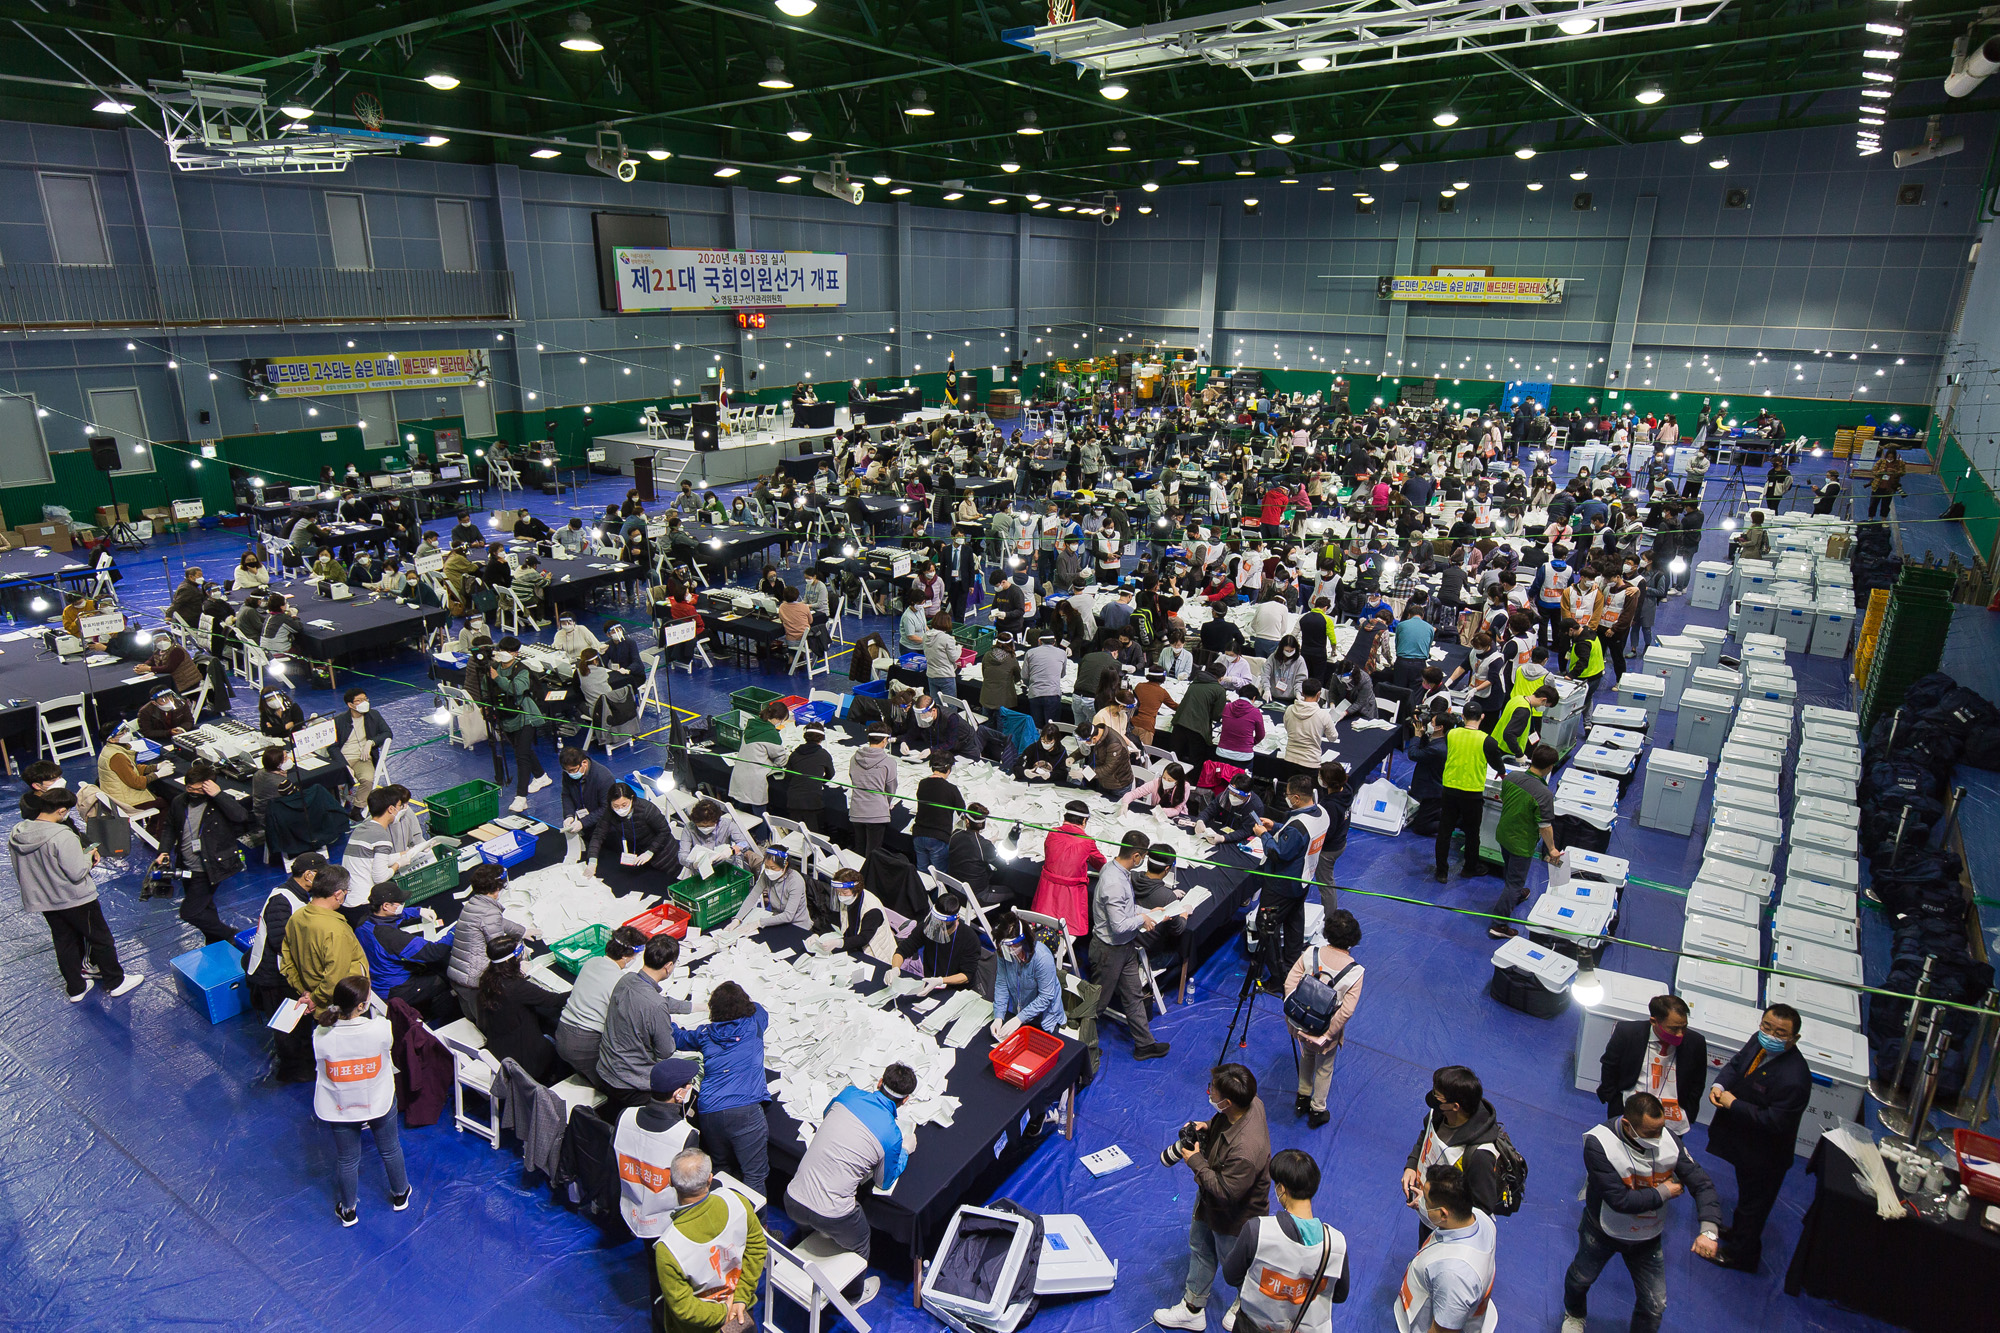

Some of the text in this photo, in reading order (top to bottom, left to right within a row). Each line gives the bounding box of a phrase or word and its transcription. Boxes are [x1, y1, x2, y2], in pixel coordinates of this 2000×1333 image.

[698, 253, 787, 266] 2020년 4월 15일 실시
[631, 266, 840, 294] 제21대 국회의원선거 개표
[1391, 280, 1547, 294] 배드민턴 고수되는 숨은 비결!! 배드민턴 필라테스
[721, 294, 783, 305] 영등포구선거관리위원회
[266, 356, 473, 383] 배드민턴 고수되는 숨은 비결!! 배드민턴 필라테스
[329, 1061, 378, 1077] 개표참관
[624, 1162, 664, 1187] 개표참관
[1268, 1277, 1309, 1298] 개표참
